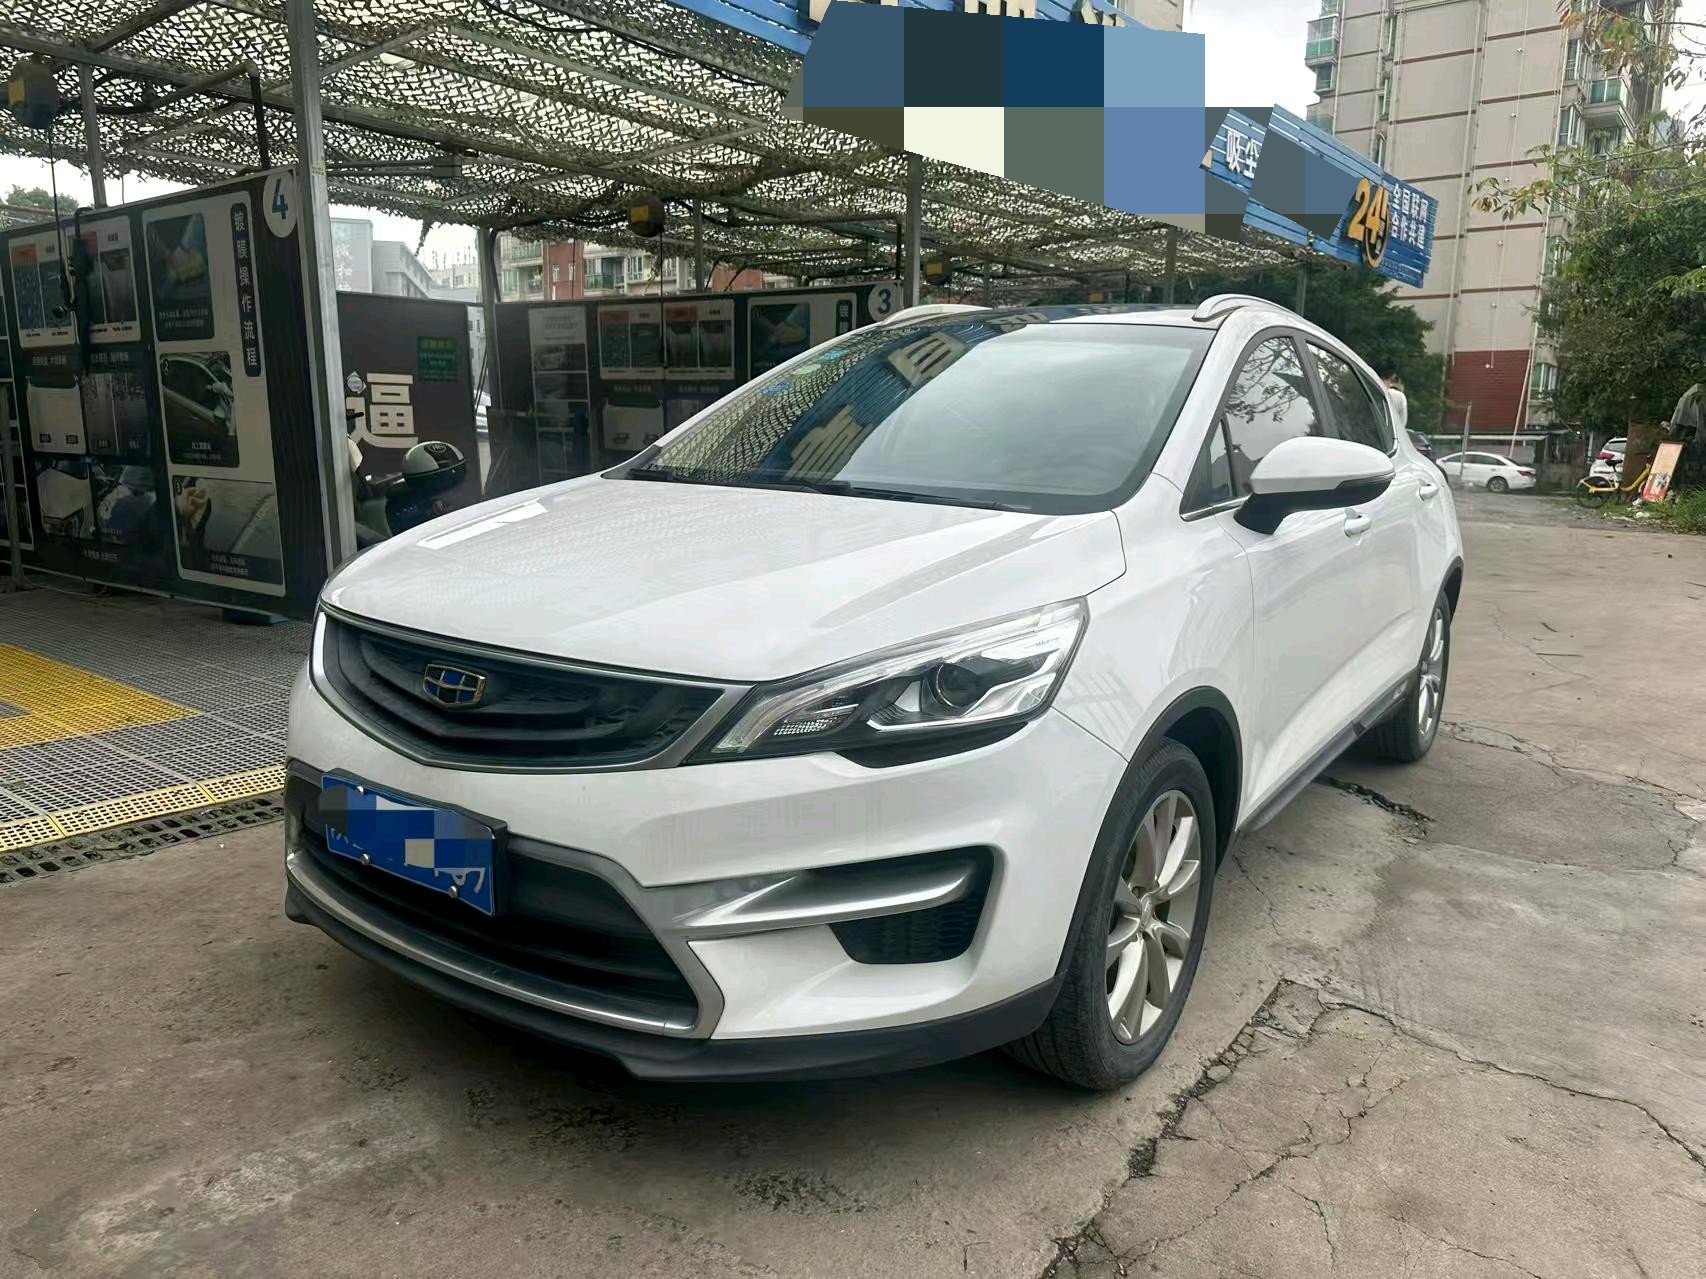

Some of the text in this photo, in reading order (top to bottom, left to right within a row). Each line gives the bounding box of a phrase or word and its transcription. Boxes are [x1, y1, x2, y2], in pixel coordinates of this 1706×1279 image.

[1226, 128, 1259, 178] 吸尘
[272, 178, 288, 219] 4
[1348, 177, 1389, 244] 24
[877, 288, 891, 314] 3
